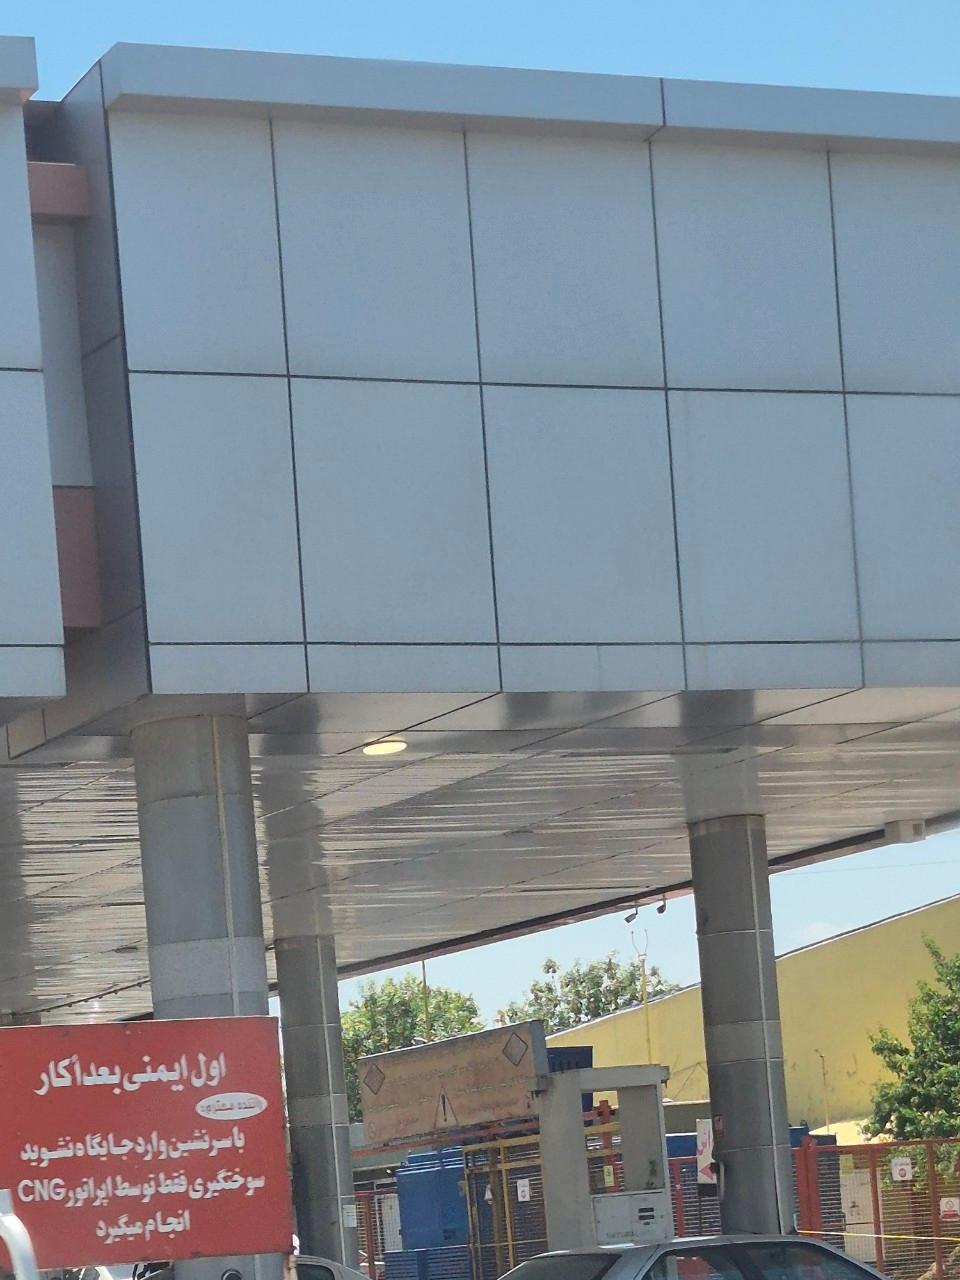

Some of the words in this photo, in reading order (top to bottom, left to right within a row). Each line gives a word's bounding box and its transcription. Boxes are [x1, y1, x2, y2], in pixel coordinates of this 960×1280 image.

[33, 1056, 73, 1095] کار
[123, 1053, 188, 1091] ایمنی
[191, 1052, 227, 1087] اول
[20, 1136, 74, 1167] نشوید
[75, 1133, 134, 1161] جایگاه
[135, 1131, 167, 1160] وارد
[17, 1178, 67, 1202] CNG
[114, 1173, 156, 1203] توسط
[158, 1169, 188, 1194] فقط
[145, 1209, 191, 1241] انجام
